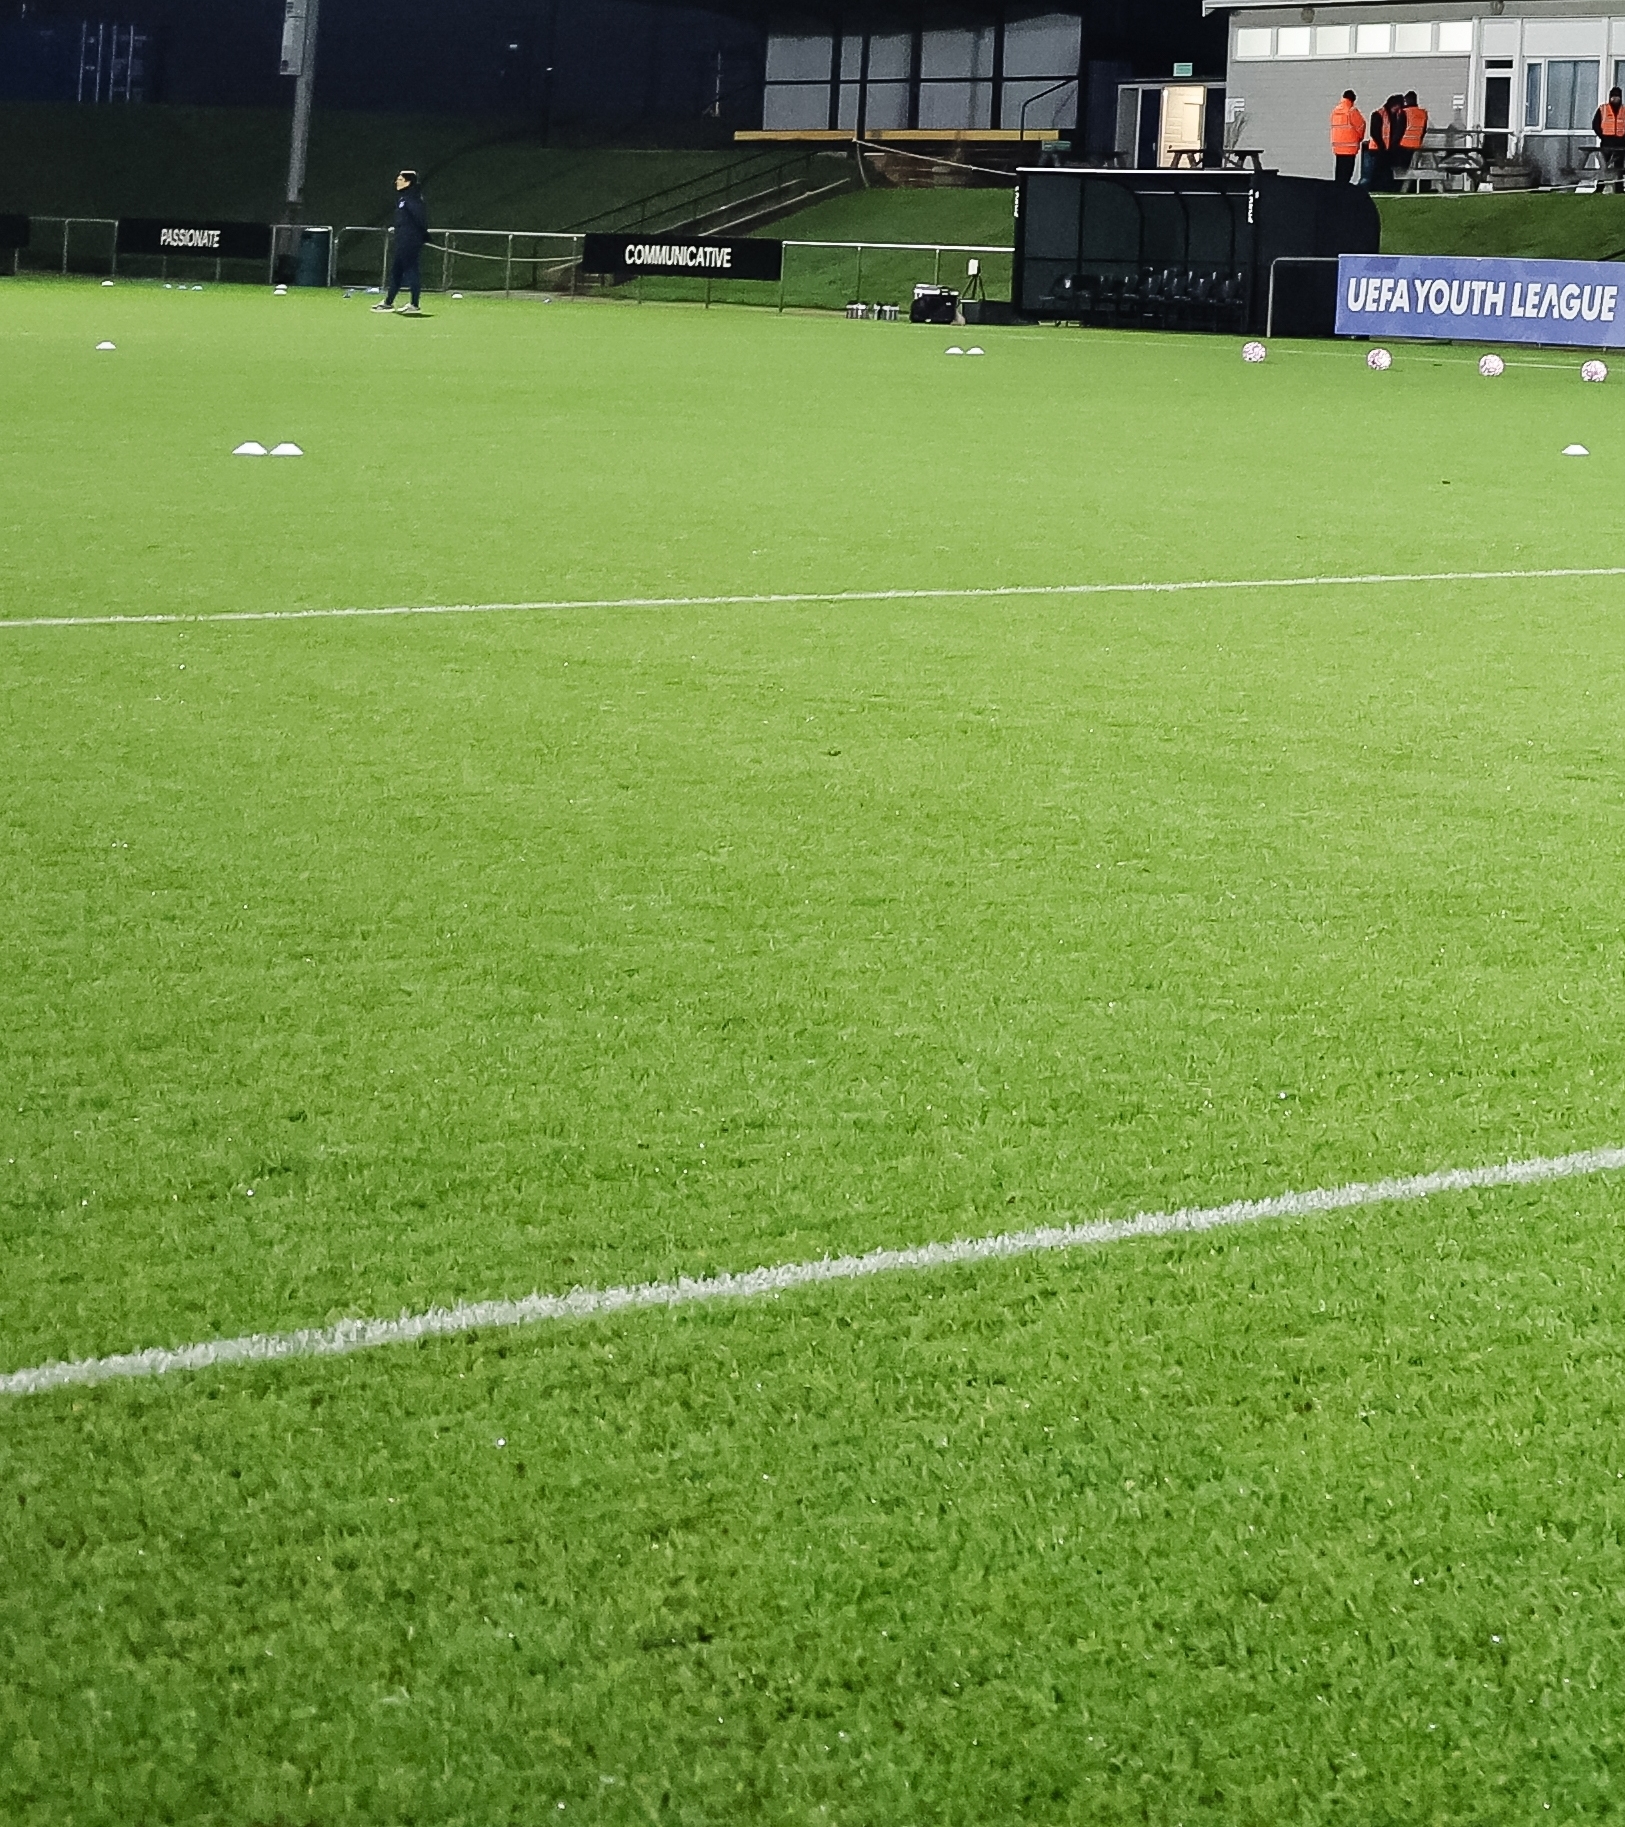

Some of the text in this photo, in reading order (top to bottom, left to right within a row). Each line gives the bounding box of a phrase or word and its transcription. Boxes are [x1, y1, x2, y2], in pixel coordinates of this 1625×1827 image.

[160, 229, 222, 248] PASSIONATE
[624, 244, 732, 268] COMMUNICATIVE
[1347, 277, 1618, 321] UEFA YOUTH LEAGUE
